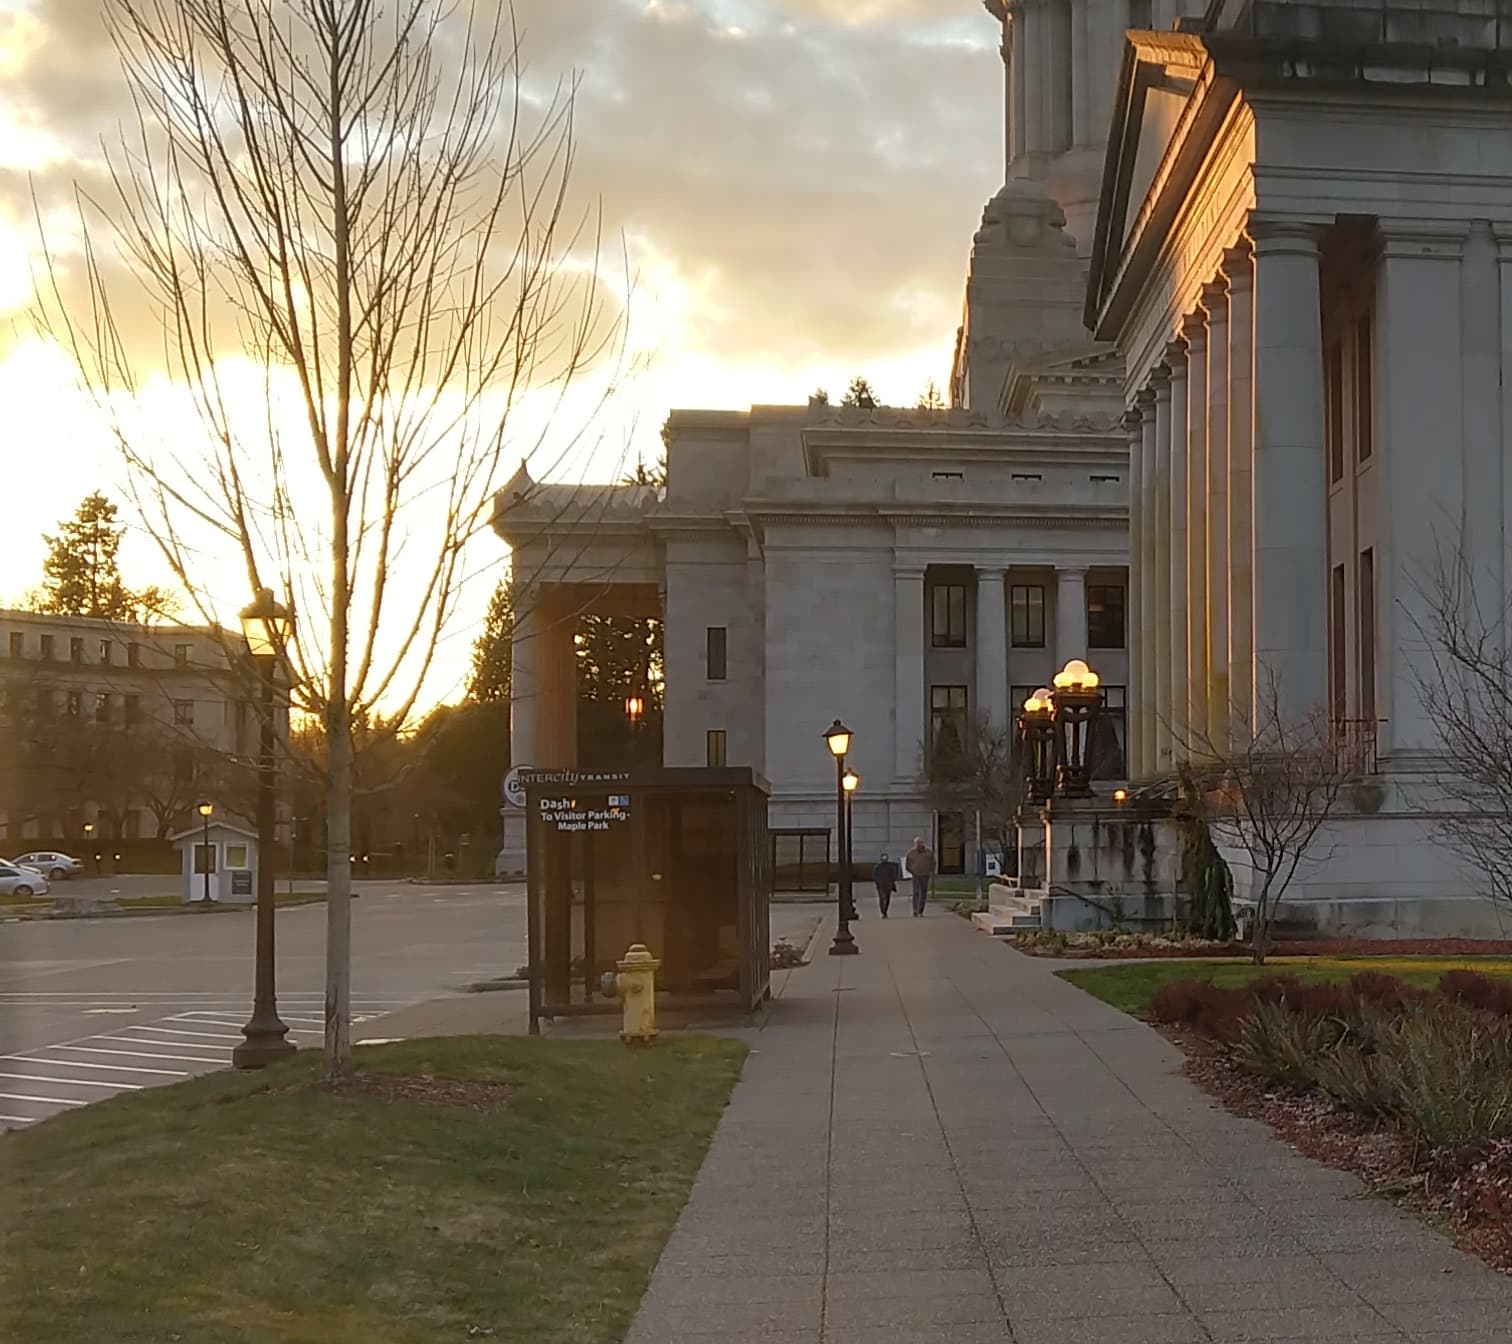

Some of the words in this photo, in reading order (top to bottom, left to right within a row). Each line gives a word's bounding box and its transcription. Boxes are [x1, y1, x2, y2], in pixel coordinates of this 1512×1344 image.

[540, 798, 570, 810] Dash
[541, 812, 553, 821] To
[554, 810, 586, 821] Visitor
[558, 821, 586, 832] Maple
[588, 820, 609, 830] Park
